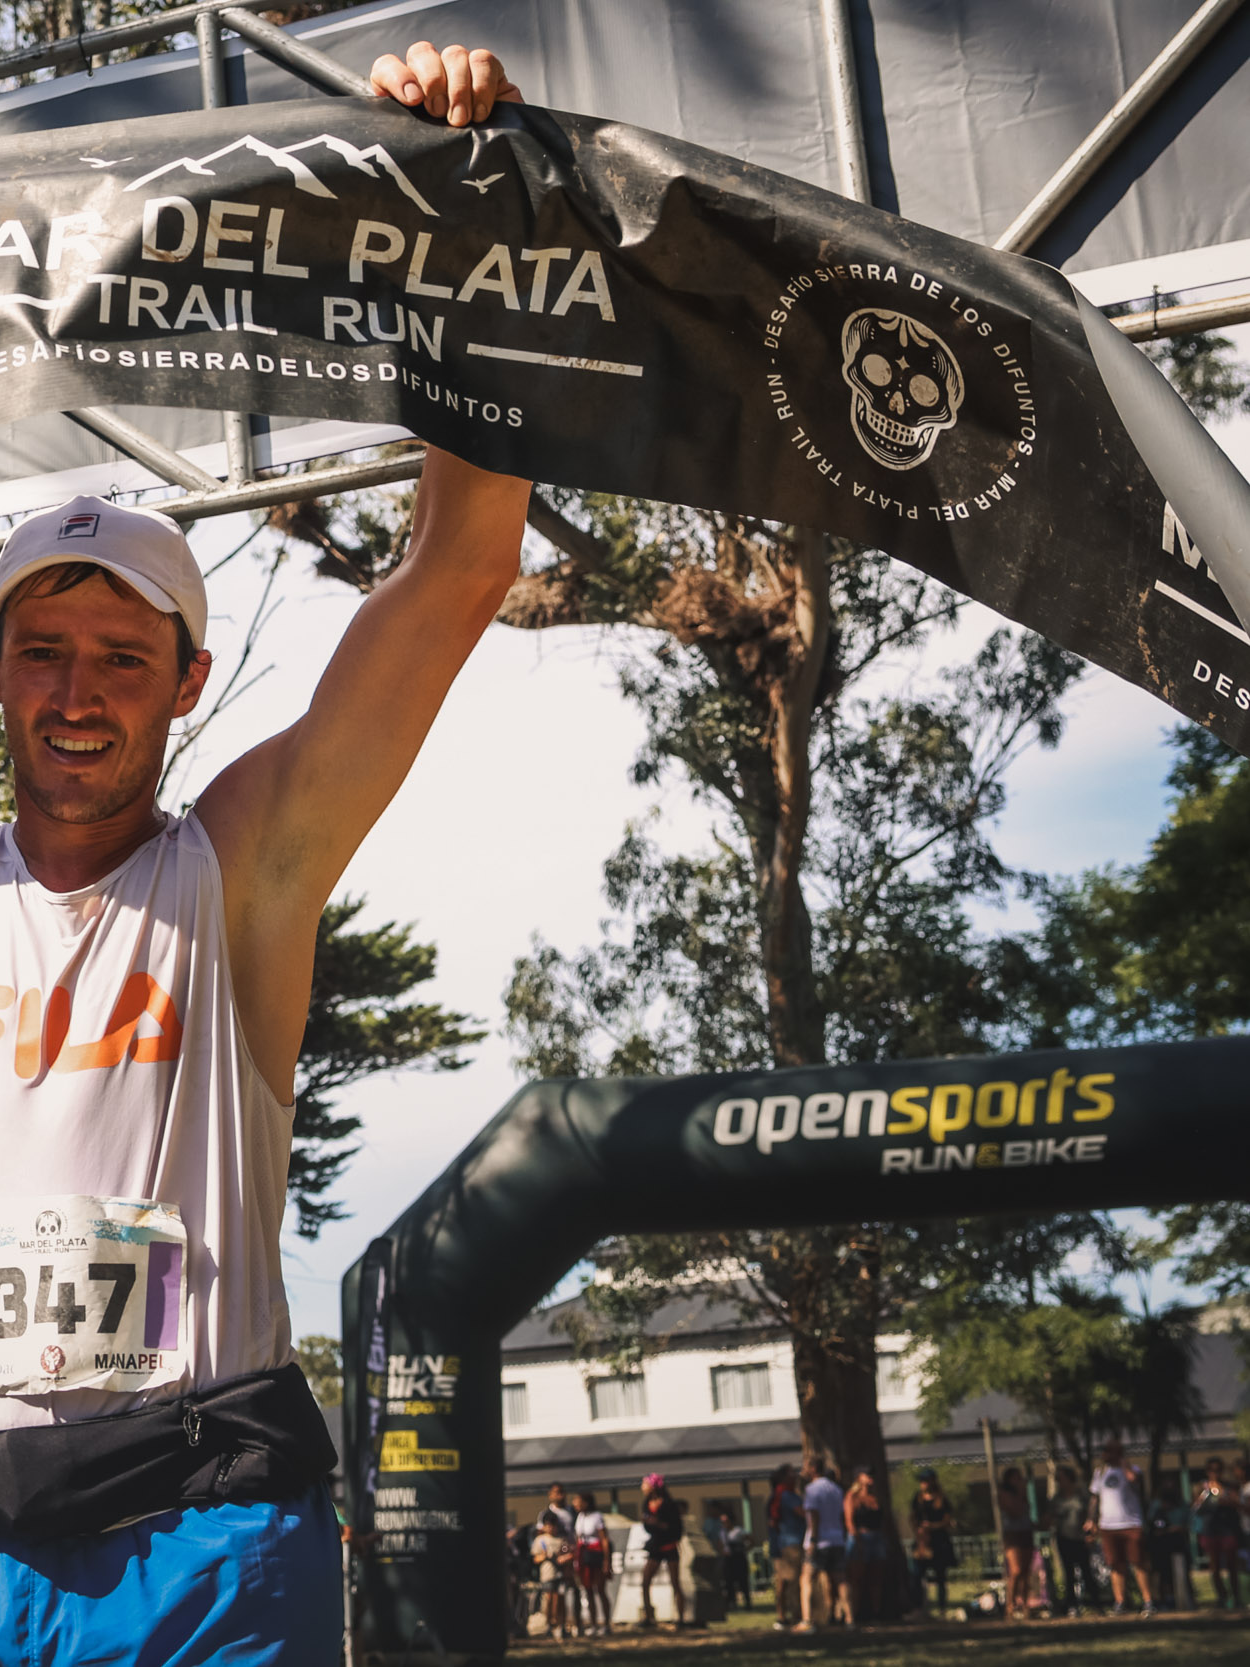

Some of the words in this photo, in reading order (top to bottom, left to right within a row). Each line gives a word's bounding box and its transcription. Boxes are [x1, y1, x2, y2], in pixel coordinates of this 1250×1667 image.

[141, 195, 309, 279] DEL
[349, 219, 616, 322] PLATA
[814, 263, 899, 283] SIERRA
[909, 272, 944, 300] DE
[86, 273, 278, 336] TRAIL
[323, 296, 445, 362] RUN
[949, 296, 993, 337] LOS
[767, 374, 794, 421] RUN
[993, 342, 1037, 456] DIFUNTOS
[791, 426, 844, 487] TRAIL
[853, 481, 919, 520] PLATA
[928, 502, 970, 521] DEL
[973, 472, 1018, 512] MAR
[713, 1067, 1116, 1155] opensports
[37, 1240, 53, 1248] DEL
[56, 1238, 87, 1246] PLATA
